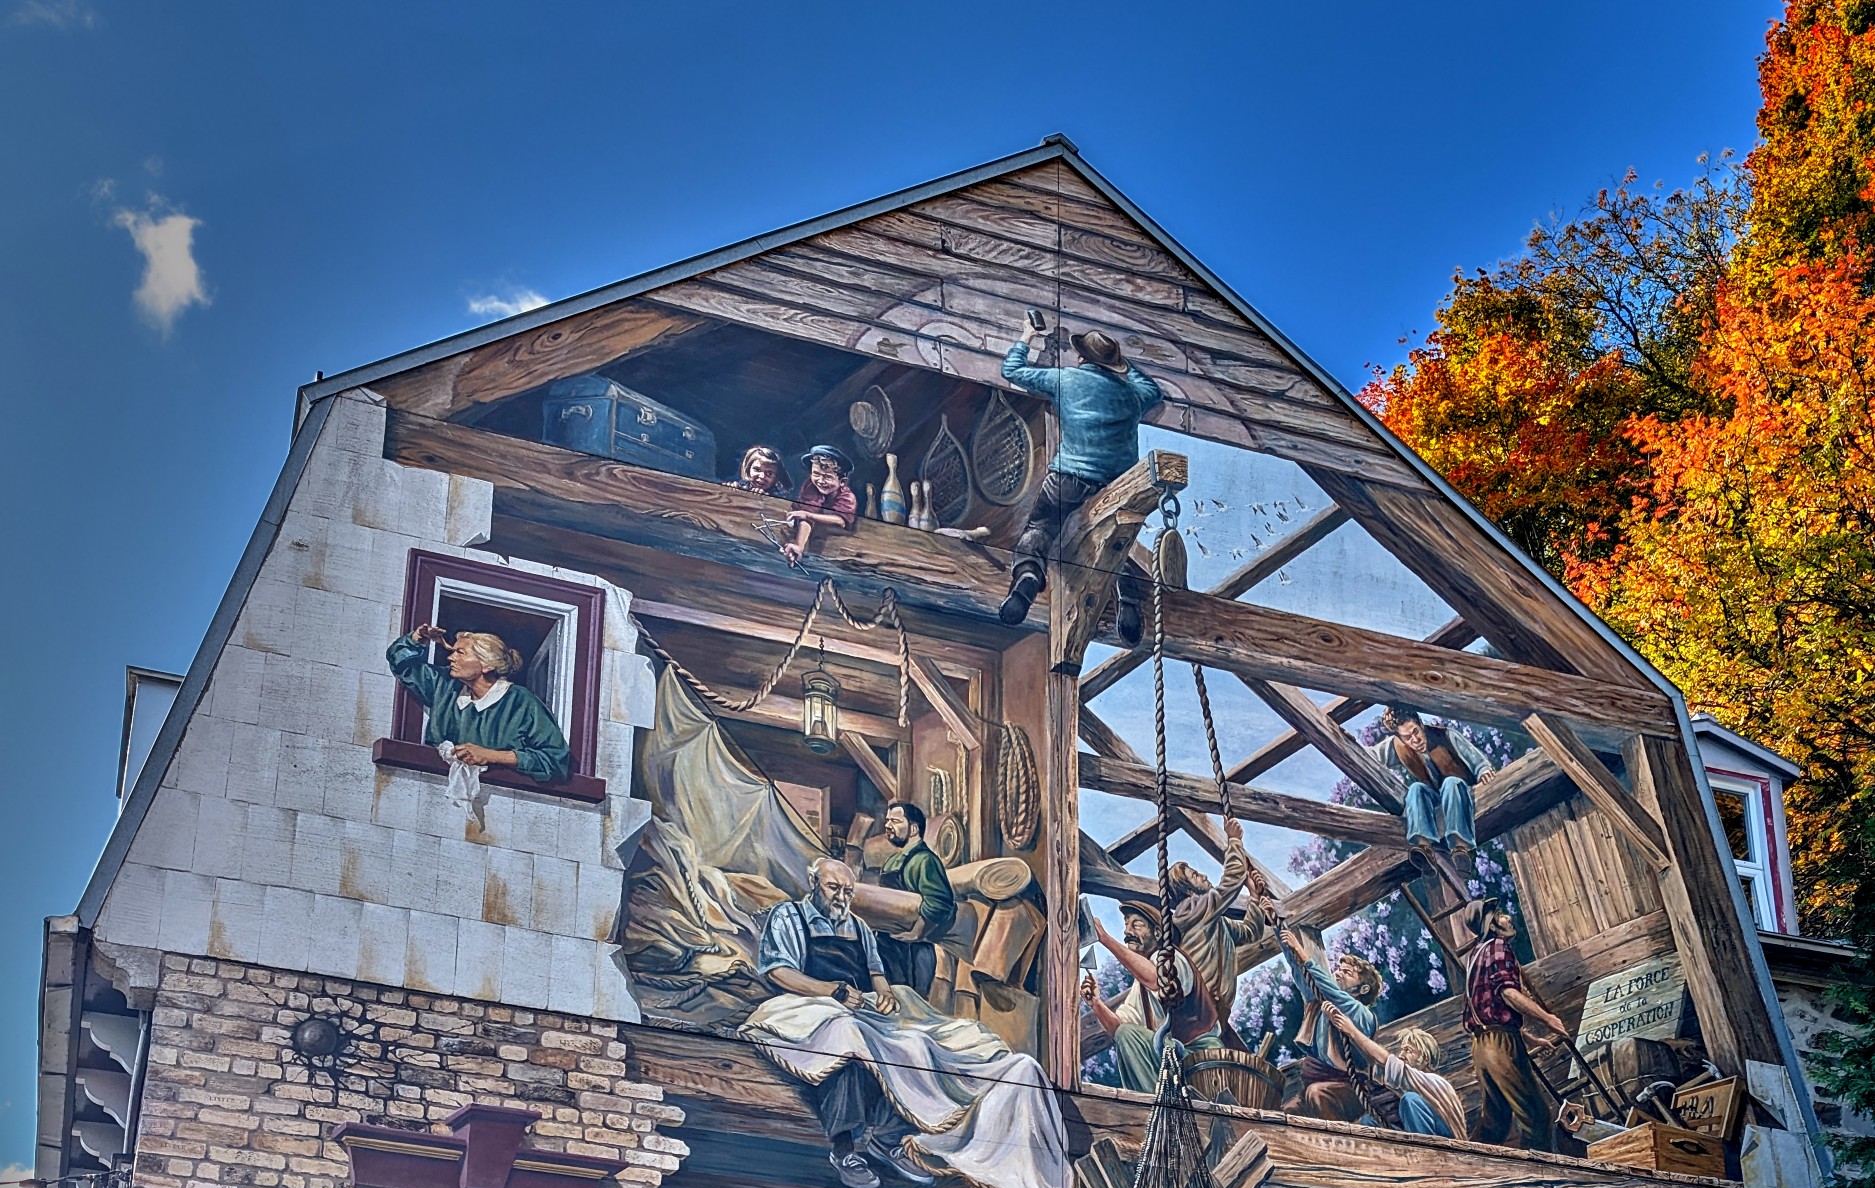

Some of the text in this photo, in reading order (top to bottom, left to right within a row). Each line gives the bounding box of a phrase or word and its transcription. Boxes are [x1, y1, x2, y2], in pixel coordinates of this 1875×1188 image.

[1604, 967, 1670, 1003] LA FORCE
[1585, 1002, 1674, 1045] COOPERATION
